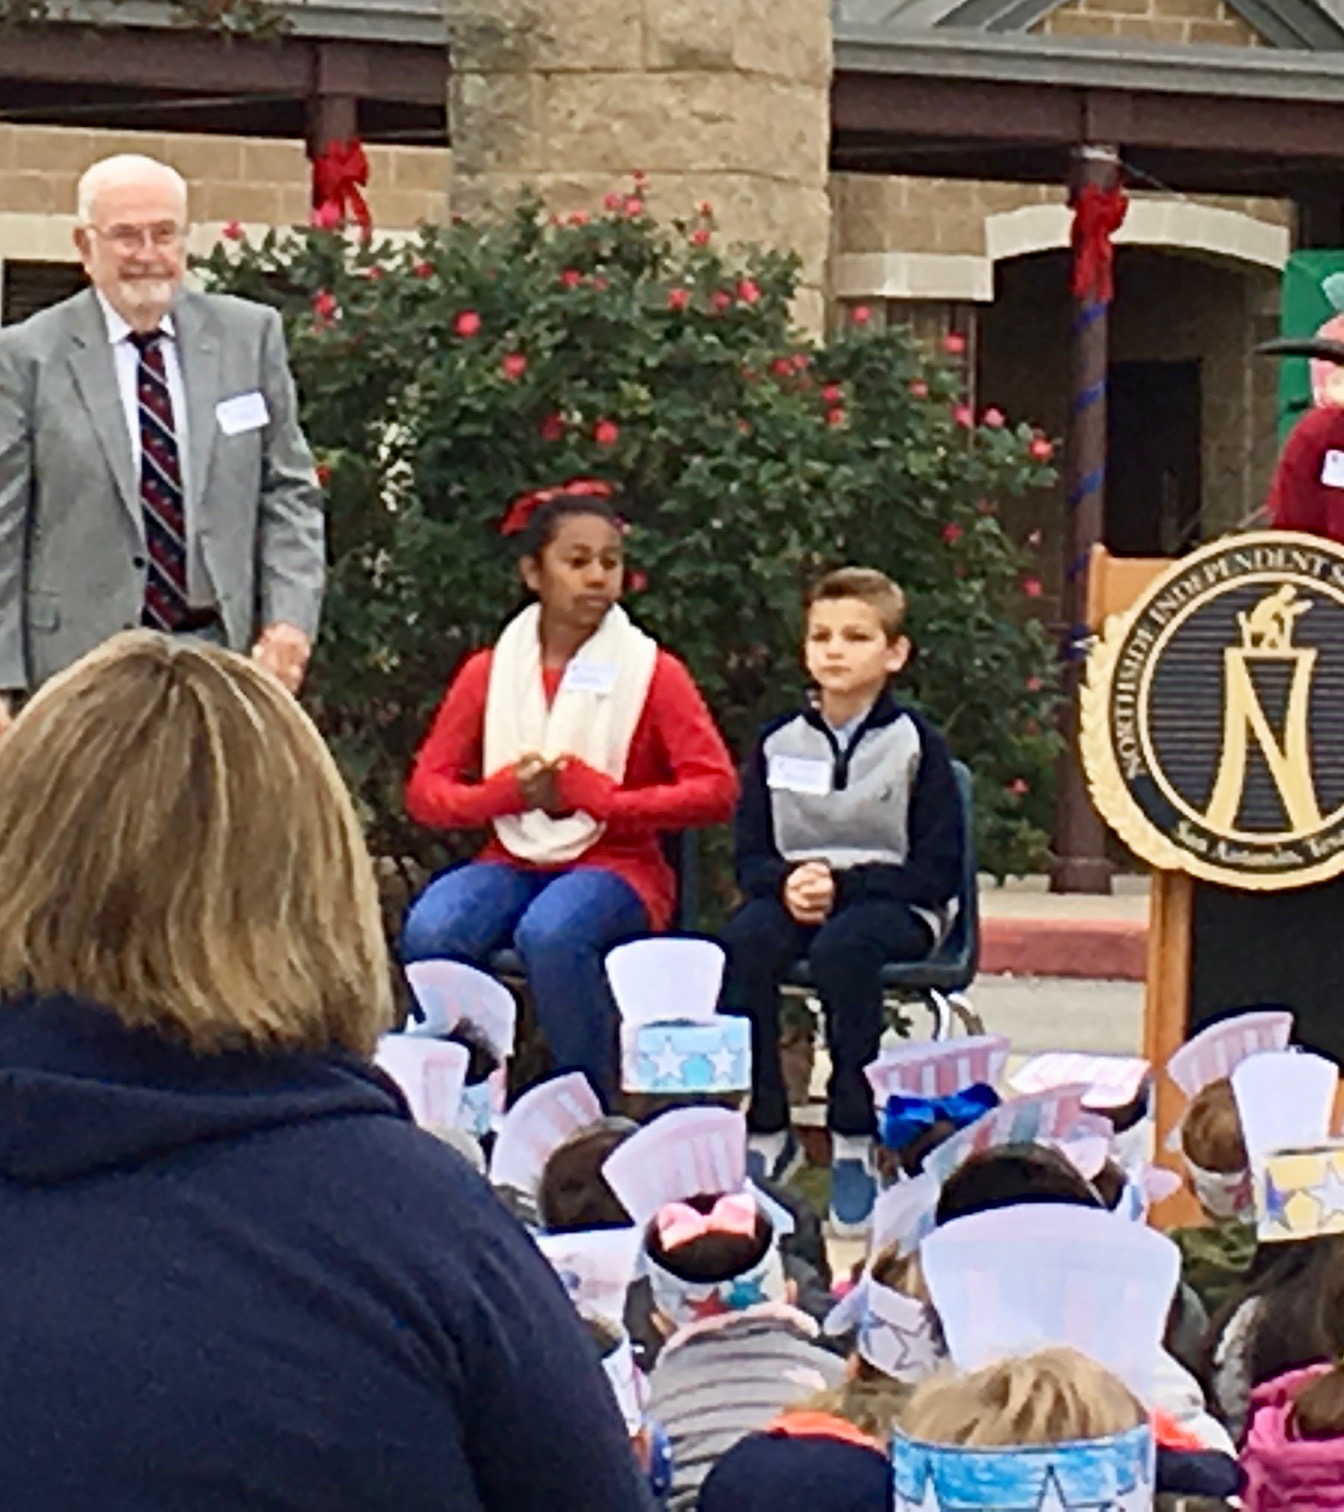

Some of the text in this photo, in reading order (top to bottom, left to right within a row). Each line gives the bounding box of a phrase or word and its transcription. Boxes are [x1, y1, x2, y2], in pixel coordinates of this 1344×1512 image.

[1116, 624, 1155, 780] NORTHSIDE
[1149, 547, 1330, 625] INDEPENDENT
[1205, 648, 1324, 835] N
